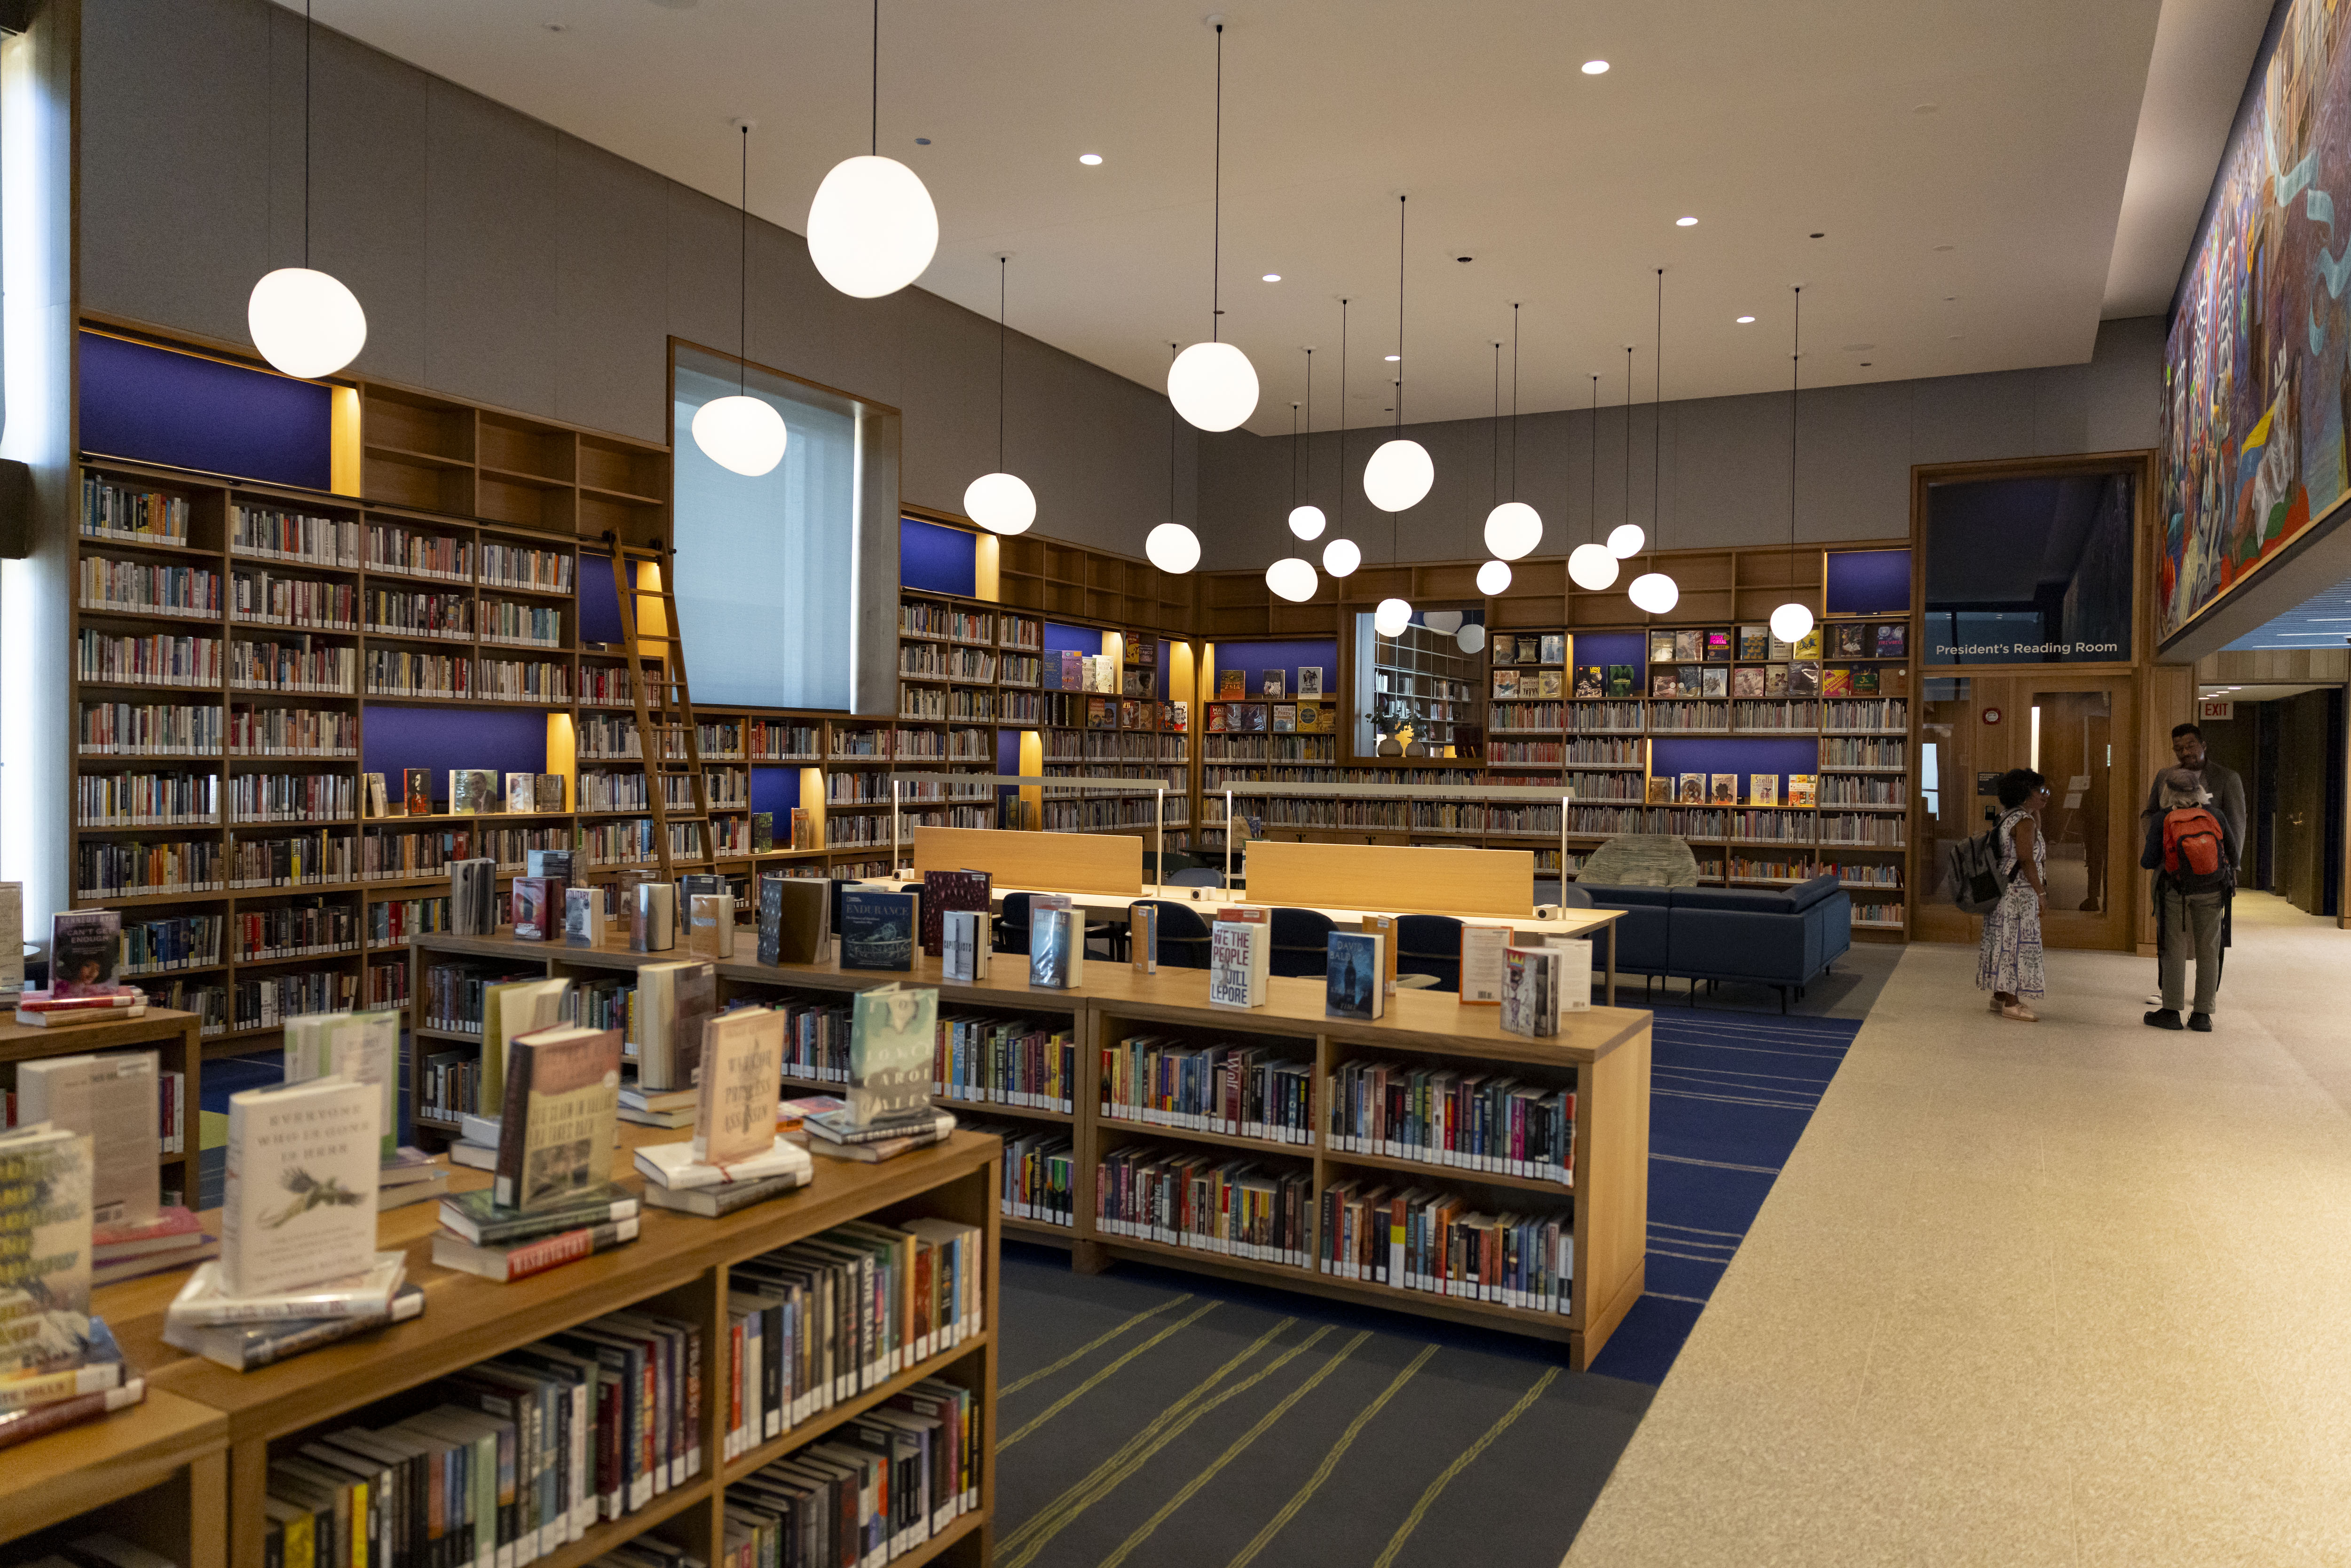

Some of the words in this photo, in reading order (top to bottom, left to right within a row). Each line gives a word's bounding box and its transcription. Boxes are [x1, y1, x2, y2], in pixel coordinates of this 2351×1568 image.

[2014, 643, 2070, 654] Reading
[2075, 642, 2117, 652] Room
[2205, 703, 2228, 716] EXIT
[411, 794, 427, 812] CHE
[566, 890, 589, 900] SOLITARY
[847, 905, 908, 916] ENDURANCE
[1214, 929, 1229, 946] WE
[1231, 930, 1249, 949] THE
[1337, 941, 1363, 952] DAVID
[1213, 946, 1249, 966] PEOPLE
[1227, 969, 1247, 986] JILL
[1211, 984, 1247, 1004] LEPORE
[863, 1068, 930, 1087] CAROL
[1227, 1057, 1239, 1090] Wolf
[269, 1105, 361, 1126] EVERYONE
[257, 1134, 300, 1146] WHO
[303, 1143, 347, 1159] HERE
[863, 1258, 874, 1304] OLIVIE
[863, 1307, 874, 1354] BLAKE
